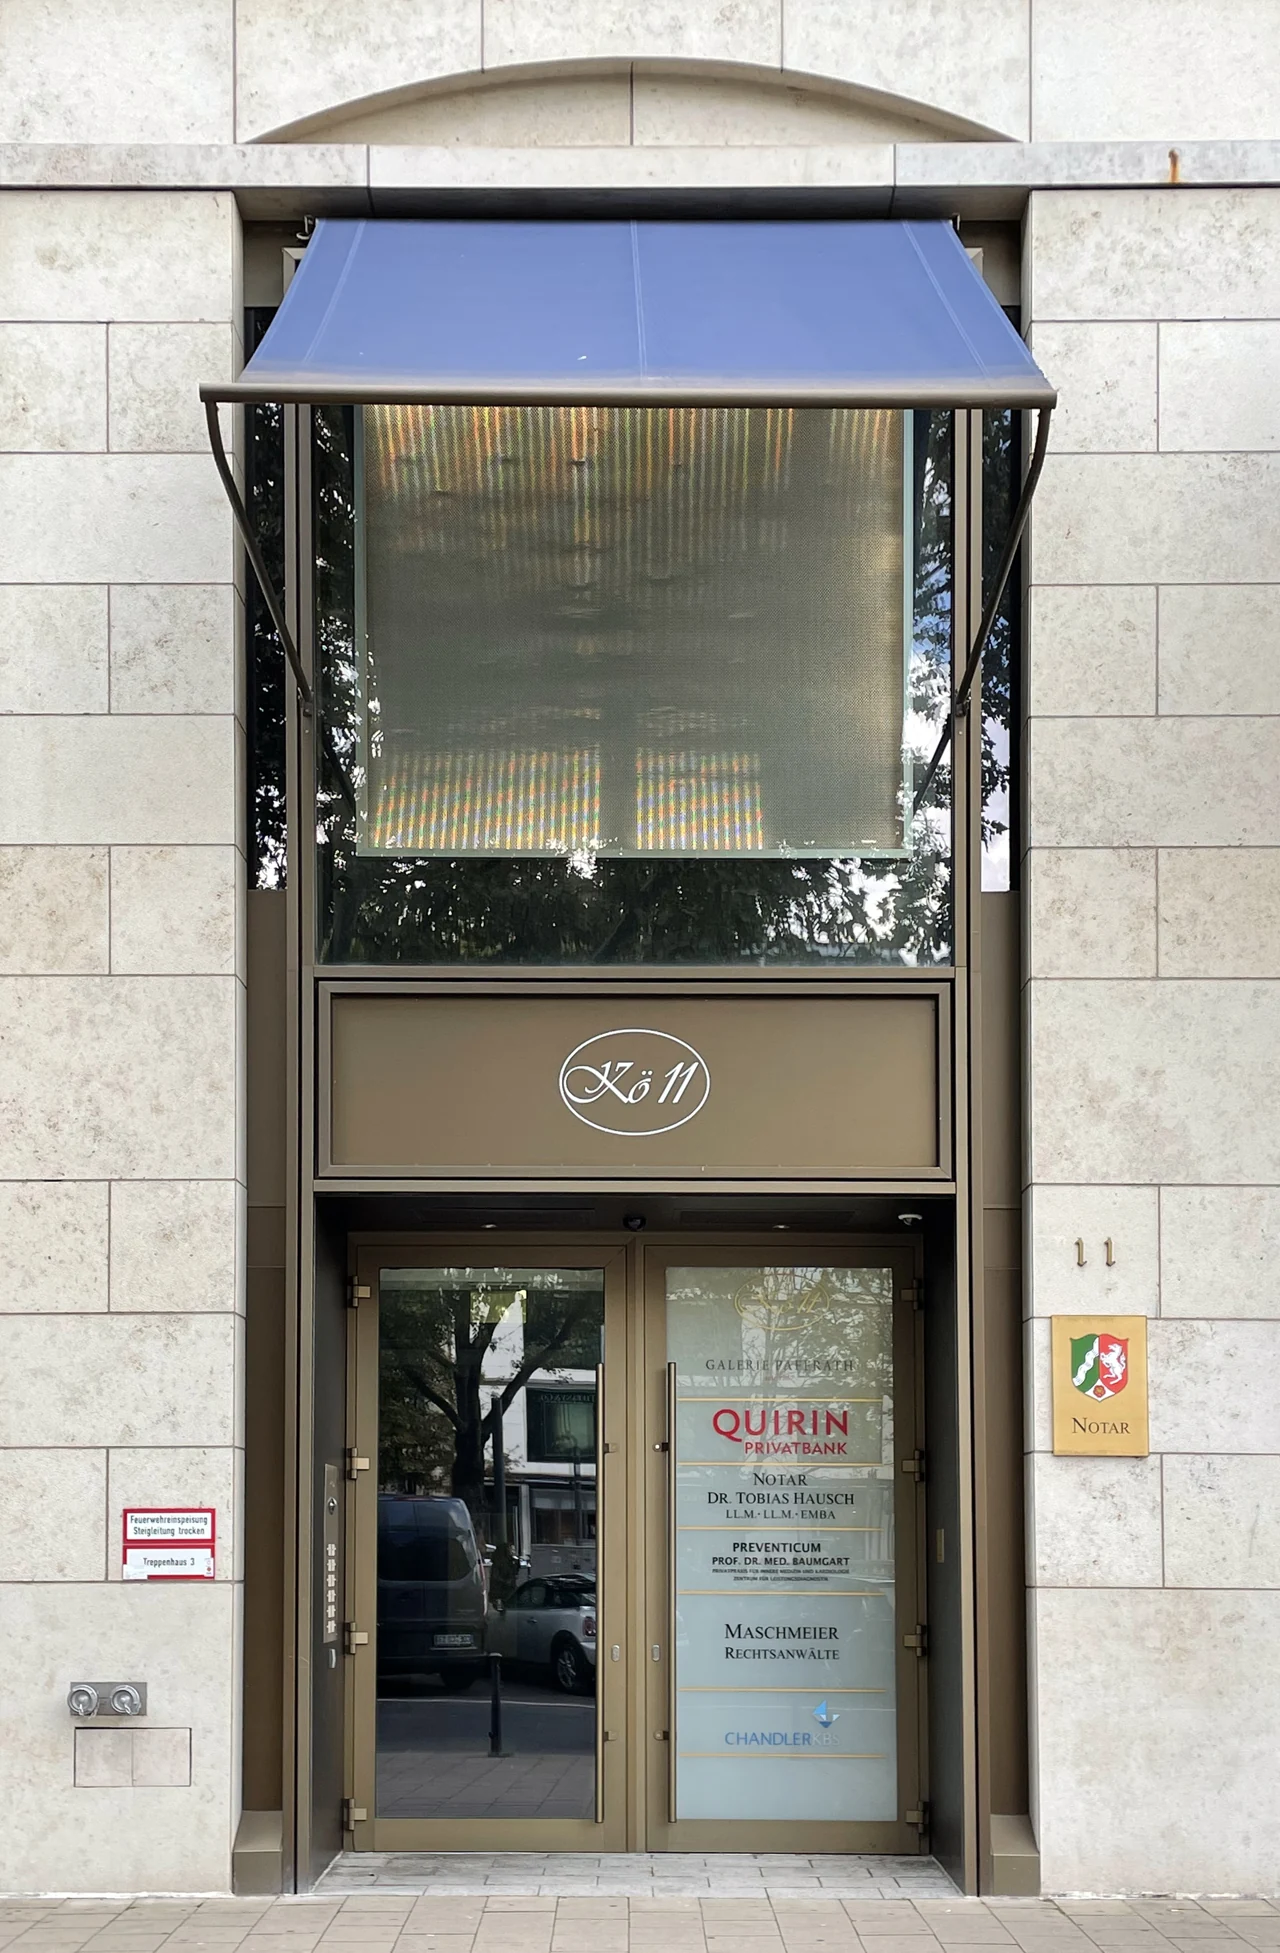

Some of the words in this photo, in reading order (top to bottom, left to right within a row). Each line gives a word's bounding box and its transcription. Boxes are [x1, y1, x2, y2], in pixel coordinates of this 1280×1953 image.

[563, 1060, 653, 1104] Kö
[657, 1061, 700, 1104] 11
[705, 1359, 770, 1371] GALERIE
[712, 1408, 849, 1443] QUIRIN
[744, 1442, 848, 1455] PRIVATBANK
[707, 1492, 732, 1505] DR.
[735, 1491, 790, 1505] TOBIAS
[793, 1492, 855, 1506] HAUSCH
[130, 1515, 208, 1526] Feuerwehreinspeisung
[800, 1510, 837, 1520] EMBA
[133, 1526, 175, 1537] Steigleitung
[178, 1526, 206, 1536] trocken
[732, 1542, 822, 1553] PREVENTICUM
[143, 1557, 187, 1568] Treppenhaus
[190, 1557, 196, 1566] 3
[712, 1557, 742, 1566] PROF.
[744, 1557, 762, 1566] DR.
[764, 1557, 790, 1566] MED.
[792, 1557, 850, 1567] BAUMGART
[724, 1623, 840, 1640] MASCHMEIER
